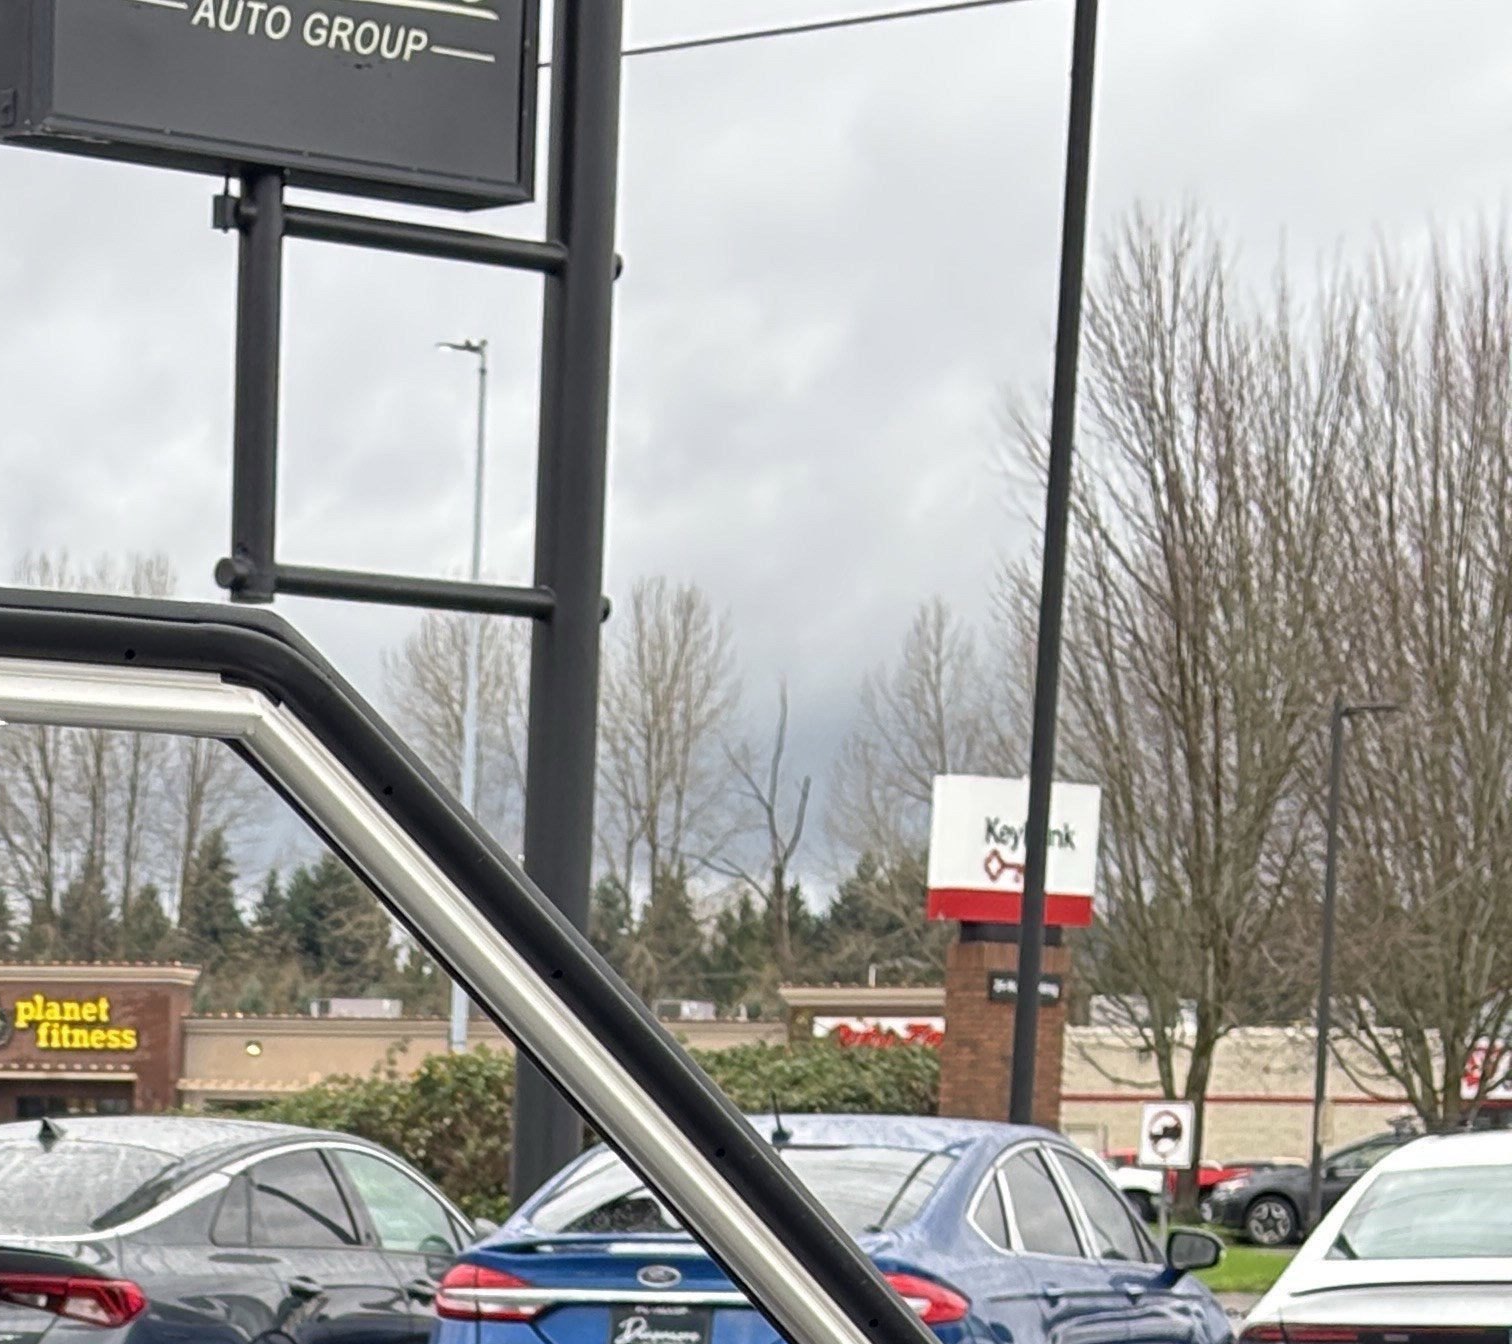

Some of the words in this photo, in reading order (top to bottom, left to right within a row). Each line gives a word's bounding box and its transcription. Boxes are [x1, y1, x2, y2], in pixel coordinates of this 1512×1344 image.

[191, 0, 291, 40] AUTO
[303, 12, 428, 61] GROUP
[985, 816, 1075, 852] Keynk
[14, 993, 111, 1029] planet
[35, 1022, 138, 1049] fitness
